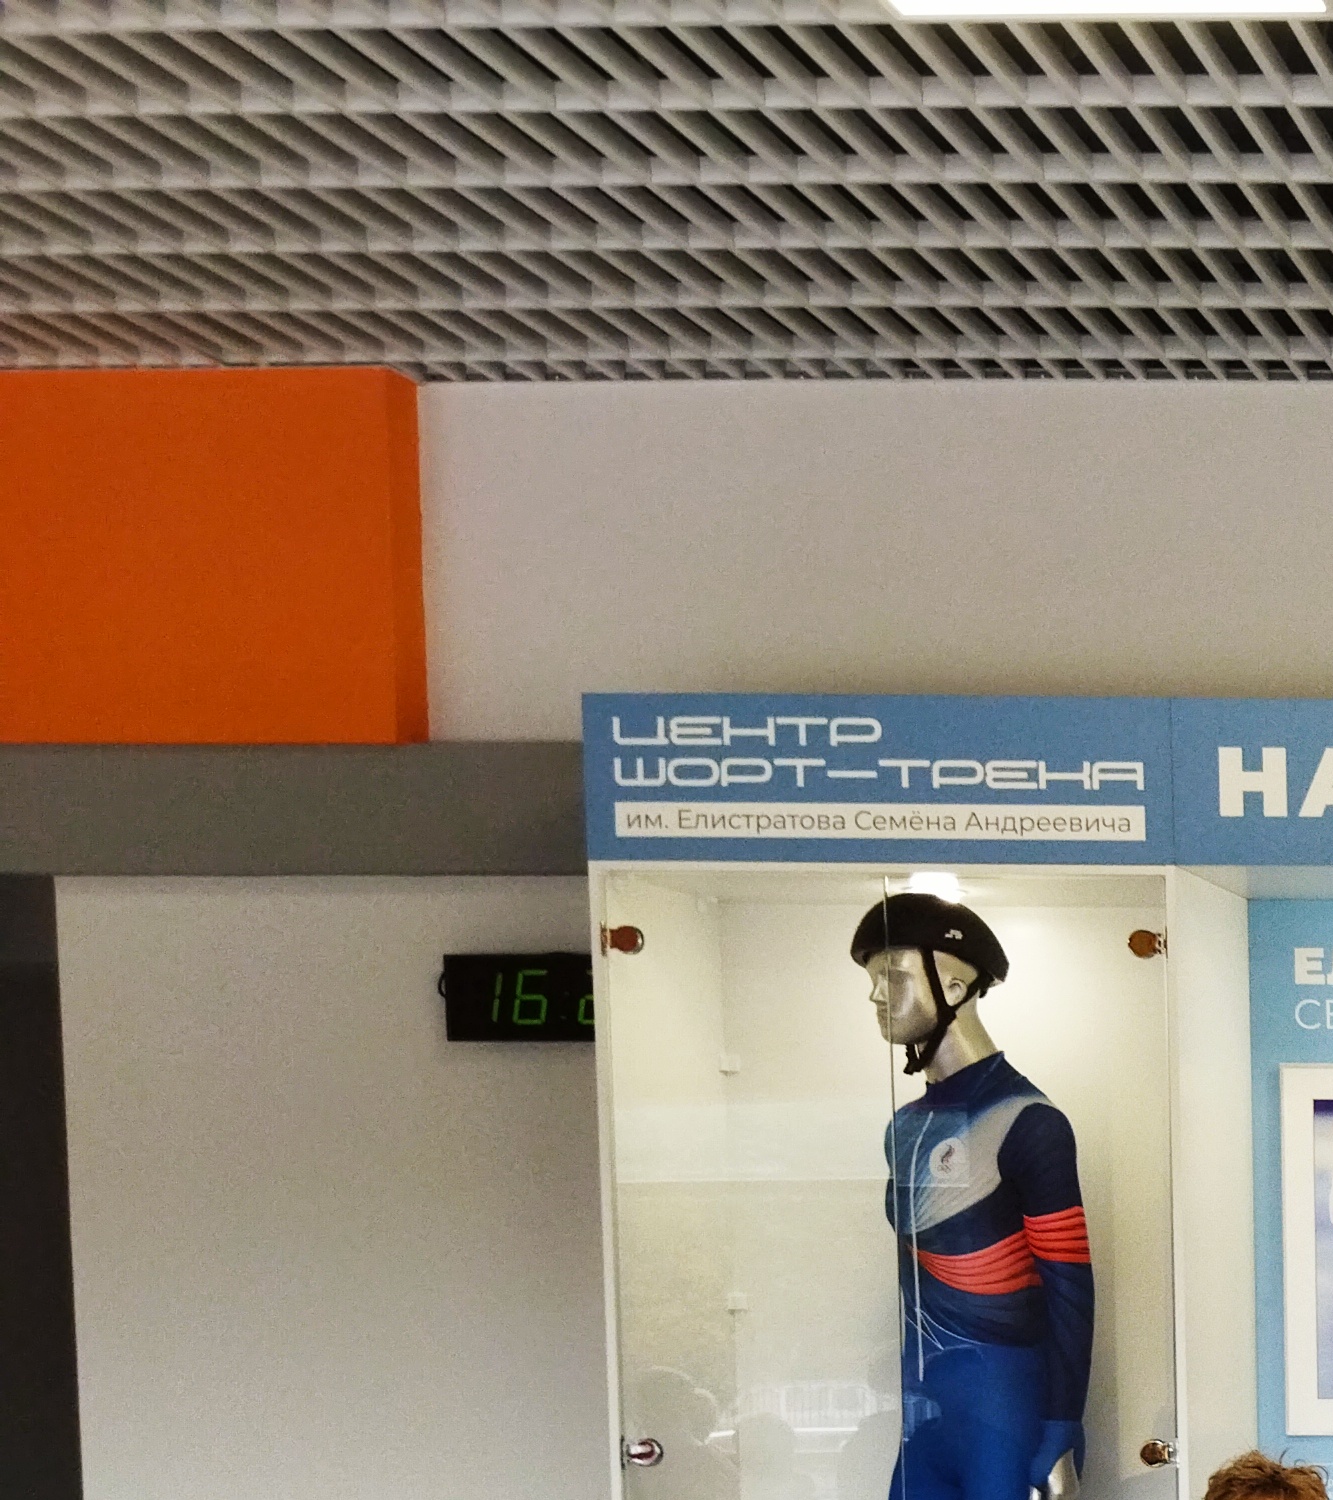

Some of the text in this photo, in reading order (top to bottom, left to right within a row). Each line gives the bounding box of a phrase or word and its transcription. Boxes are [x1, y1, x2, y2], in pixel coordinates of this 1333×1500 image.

[612, 716, 881, 746] ЦЕНТР
[627, 810, 1130, 839] им. Елистратова Семёна Андреевича
